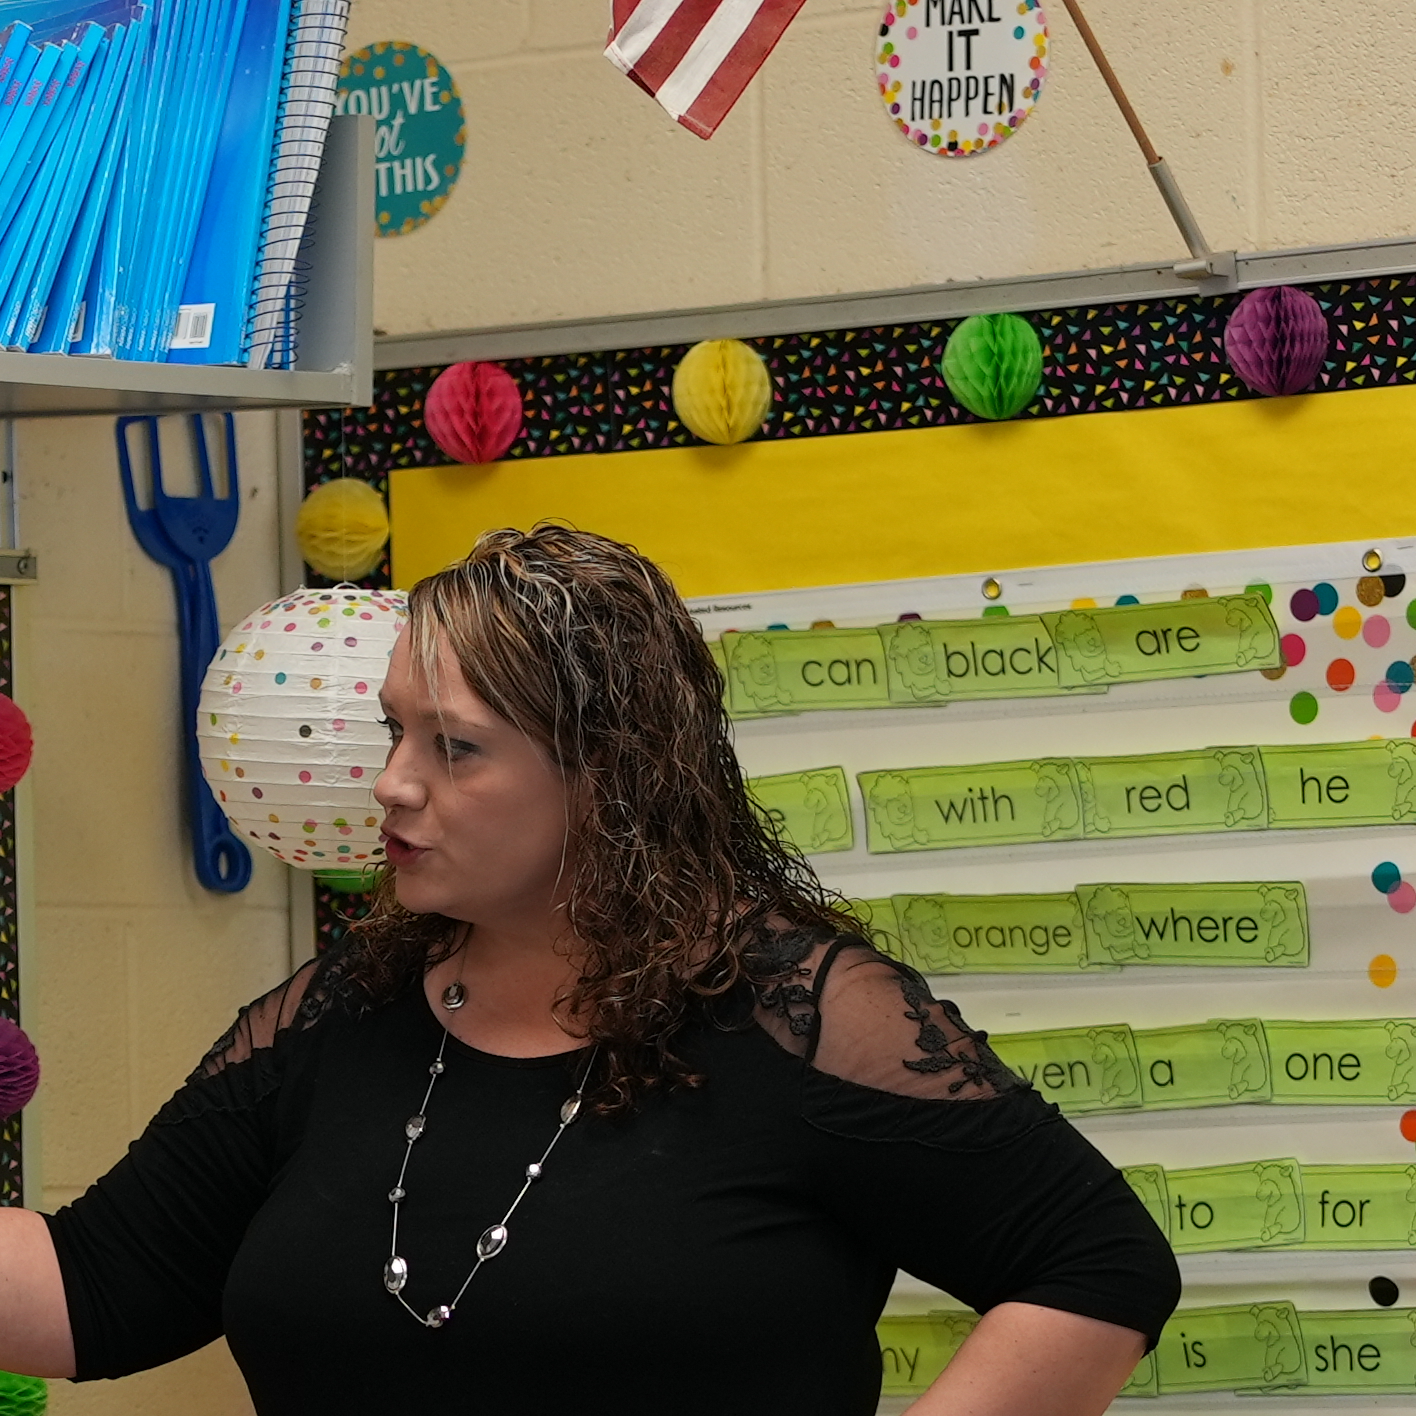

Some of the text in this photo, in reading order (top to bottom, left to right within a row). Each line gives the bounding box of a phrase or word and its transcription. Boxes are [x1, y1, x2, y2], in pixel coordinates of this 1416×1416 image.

[948, 29, 980, 72] IT
[911, 73, 1015, 122] HAPPEN
[376, 110, 406, 157] ot
[375, 154, 441, 196] THIS
[801, 623, 1201, 688] can black are
[935, 768, 1351, 824] with red he
[953, 908, 1259, 955] orange where
[1018, 1050, 1361, 1089] ven a one
[1175, 1189, 1371, 1230] to for
[1183, 1332, 1207, 1369] is
[1314, 1336, 1381, 1372] she
